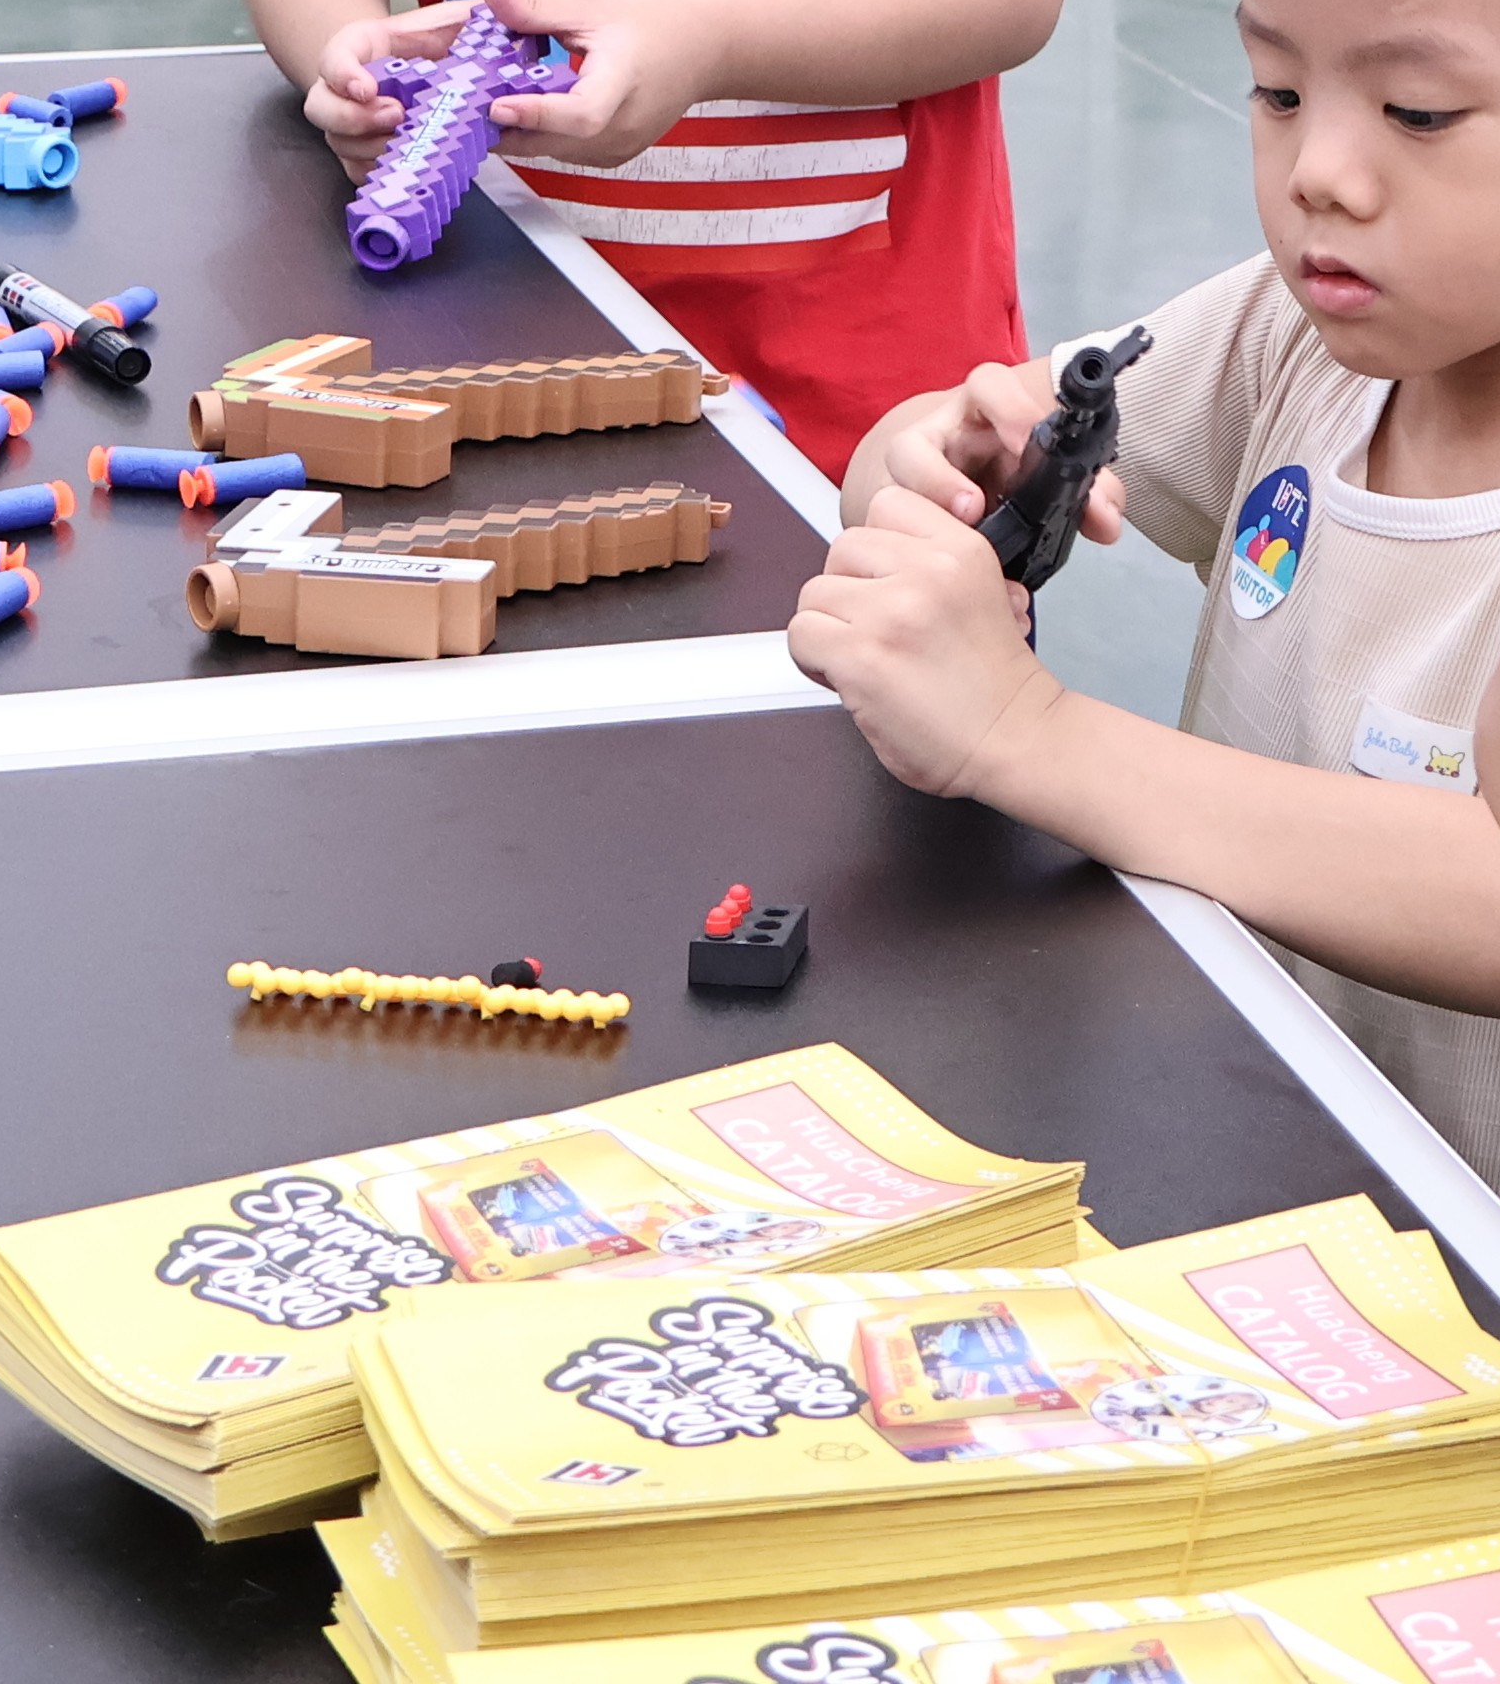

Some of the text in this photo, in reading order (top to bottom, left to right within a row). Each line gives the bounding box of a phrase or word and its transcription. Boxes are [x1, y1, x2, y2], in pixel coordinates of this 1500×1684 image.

[1271, 478, 1309, 528] IBTE
[1232, 564, 1275, 610] VISITOR
[1362, 726, 1420, 766] John Baby
[722, 1117, 906, 1217] CATALOG
[789, 1115, 939, 1199] HuaCheng
[164, 1228, 380, 1329] Pocket
[238, 1179, 448, 1287] Surprise
[255, 1222, 382, 1291] in the
[659, 1299, 860, 1419] Surprise
[663, 1340, 782, 1417] in the
[1211, 1284, 1370, 1402] CATALOG
[1286, 1283, 1414, 1385] HuaCheng
[553, 1341, 771, 1446] Pocket
